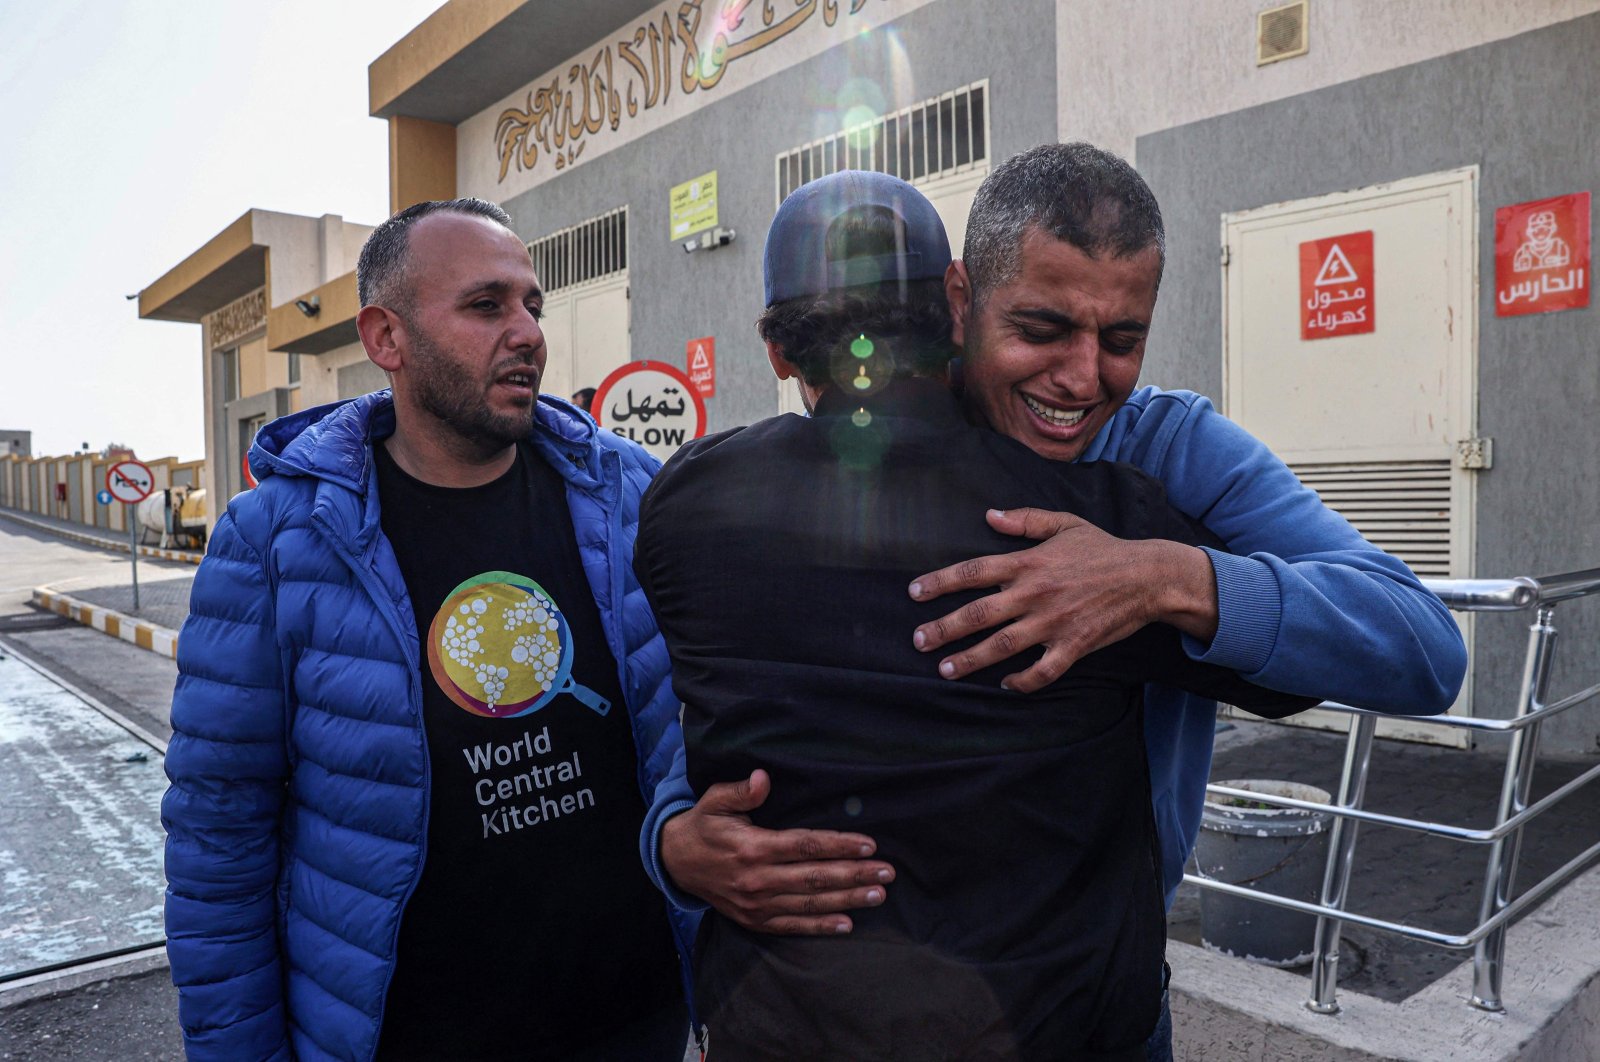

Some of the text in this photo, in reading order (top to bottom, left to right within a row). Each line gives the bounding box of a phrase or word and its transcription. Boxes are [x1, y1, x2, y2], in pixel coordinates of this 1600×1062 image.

[1307, 287, 1366, 309] محول
[1499, 268, 1584, 304] الحارس
[1307, 305, 1366, 331] كهرباء
[611, 387, 685, 422] تمهل
[463, 726, 552, 775] World
[475, 752, 582, 806] Central
[481, 788, 596, 839] Kitchen
